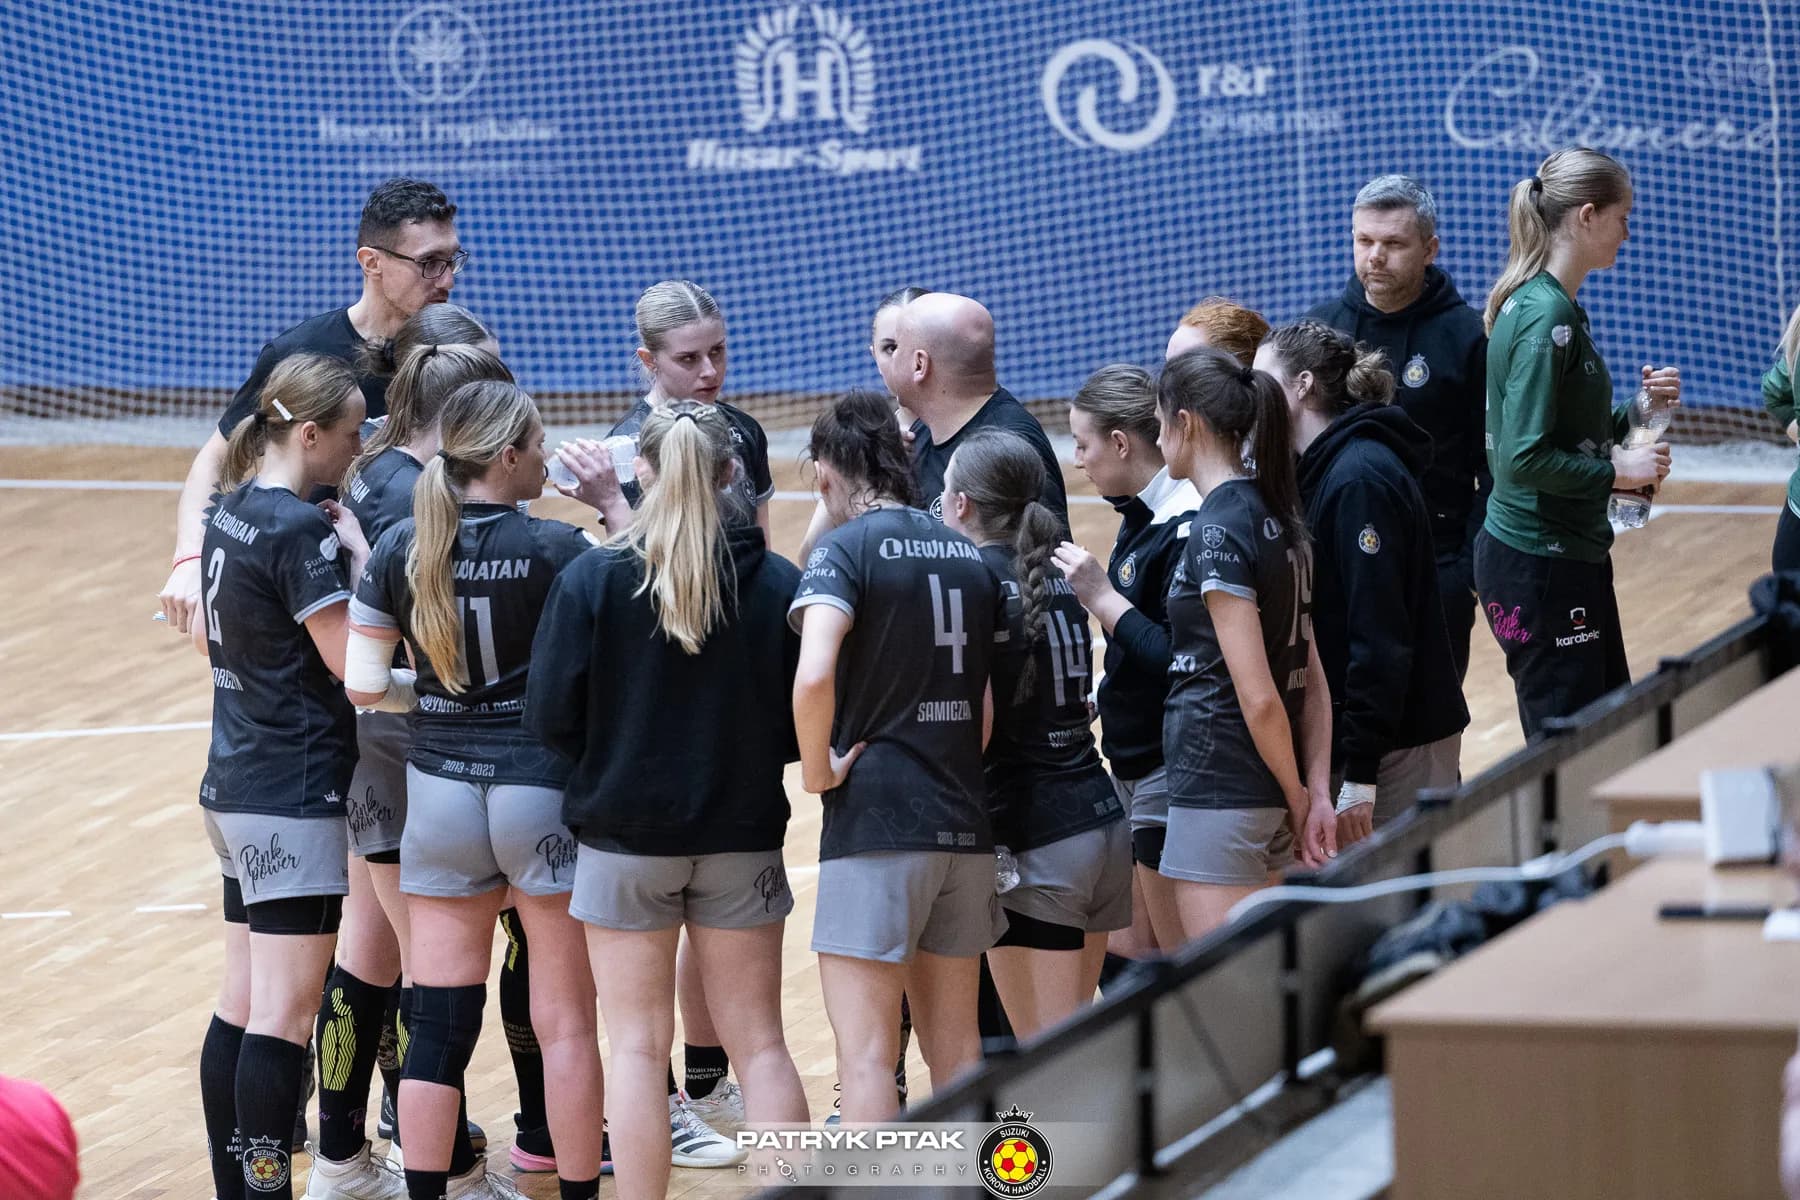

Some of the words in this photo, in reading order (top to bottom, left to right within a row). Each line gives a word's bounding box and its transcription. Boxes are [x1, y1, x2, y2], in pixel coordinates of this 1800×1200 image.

[1199, 64, 1275, 97] r&r
[206, 547, 226, 647] 2
[928, 574, 967, 674] 4
[1039, 610, 1088, 707] 14
[442, 760, 464, 773] 2013
[470, 763, 495, 777] 2023
[240, 833, 284, 877] Pink
[253, 1150, 279, 1159] SUZUKI
